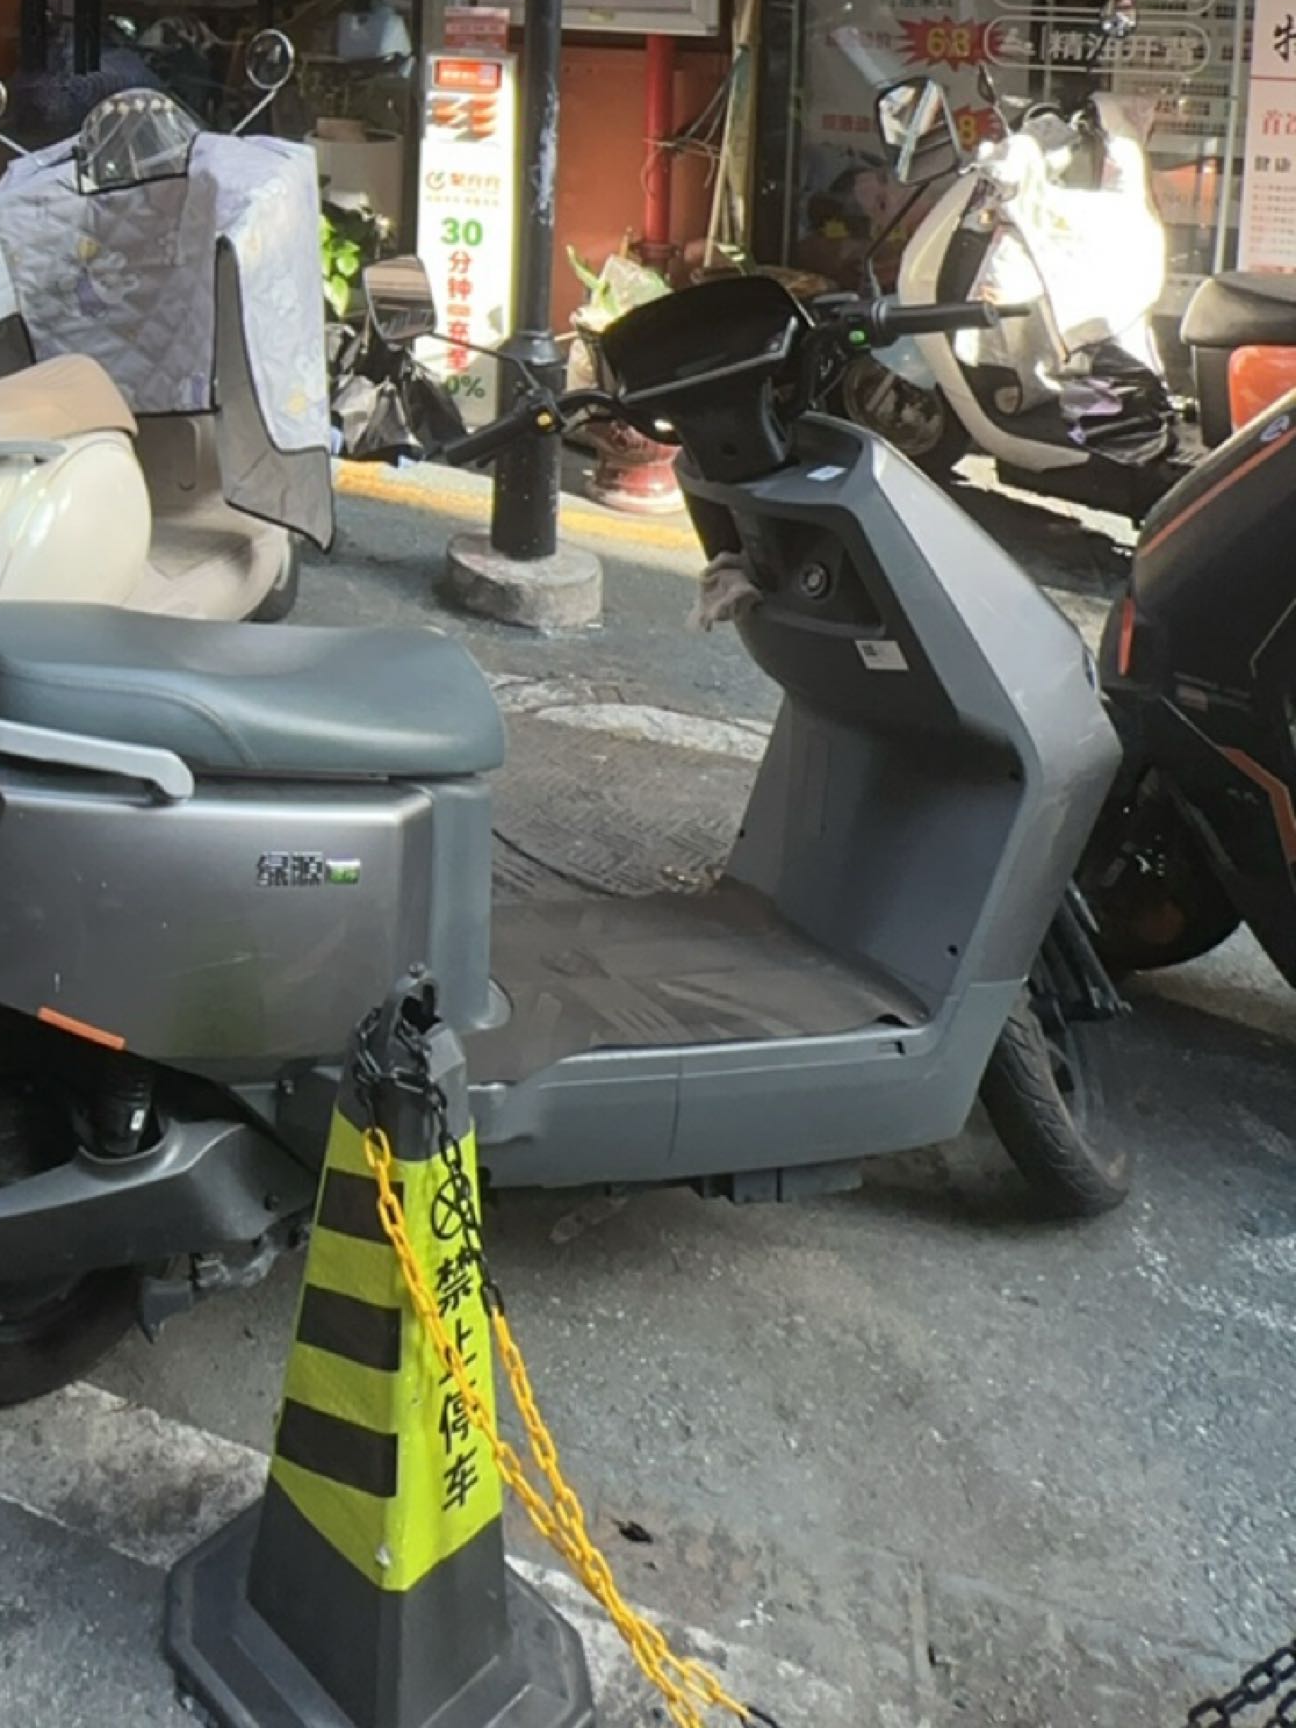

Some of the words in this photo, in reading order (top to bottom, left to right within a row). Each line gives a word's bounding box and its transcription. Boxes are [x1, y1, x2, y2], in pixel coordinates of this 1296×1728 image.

[926, 27, 972, 58] 68
[1048, 30, 1196, 65] 精油开背
[440, 216, 484, 247] 30
[436, 1247, 479, 1512] 禁止停车
